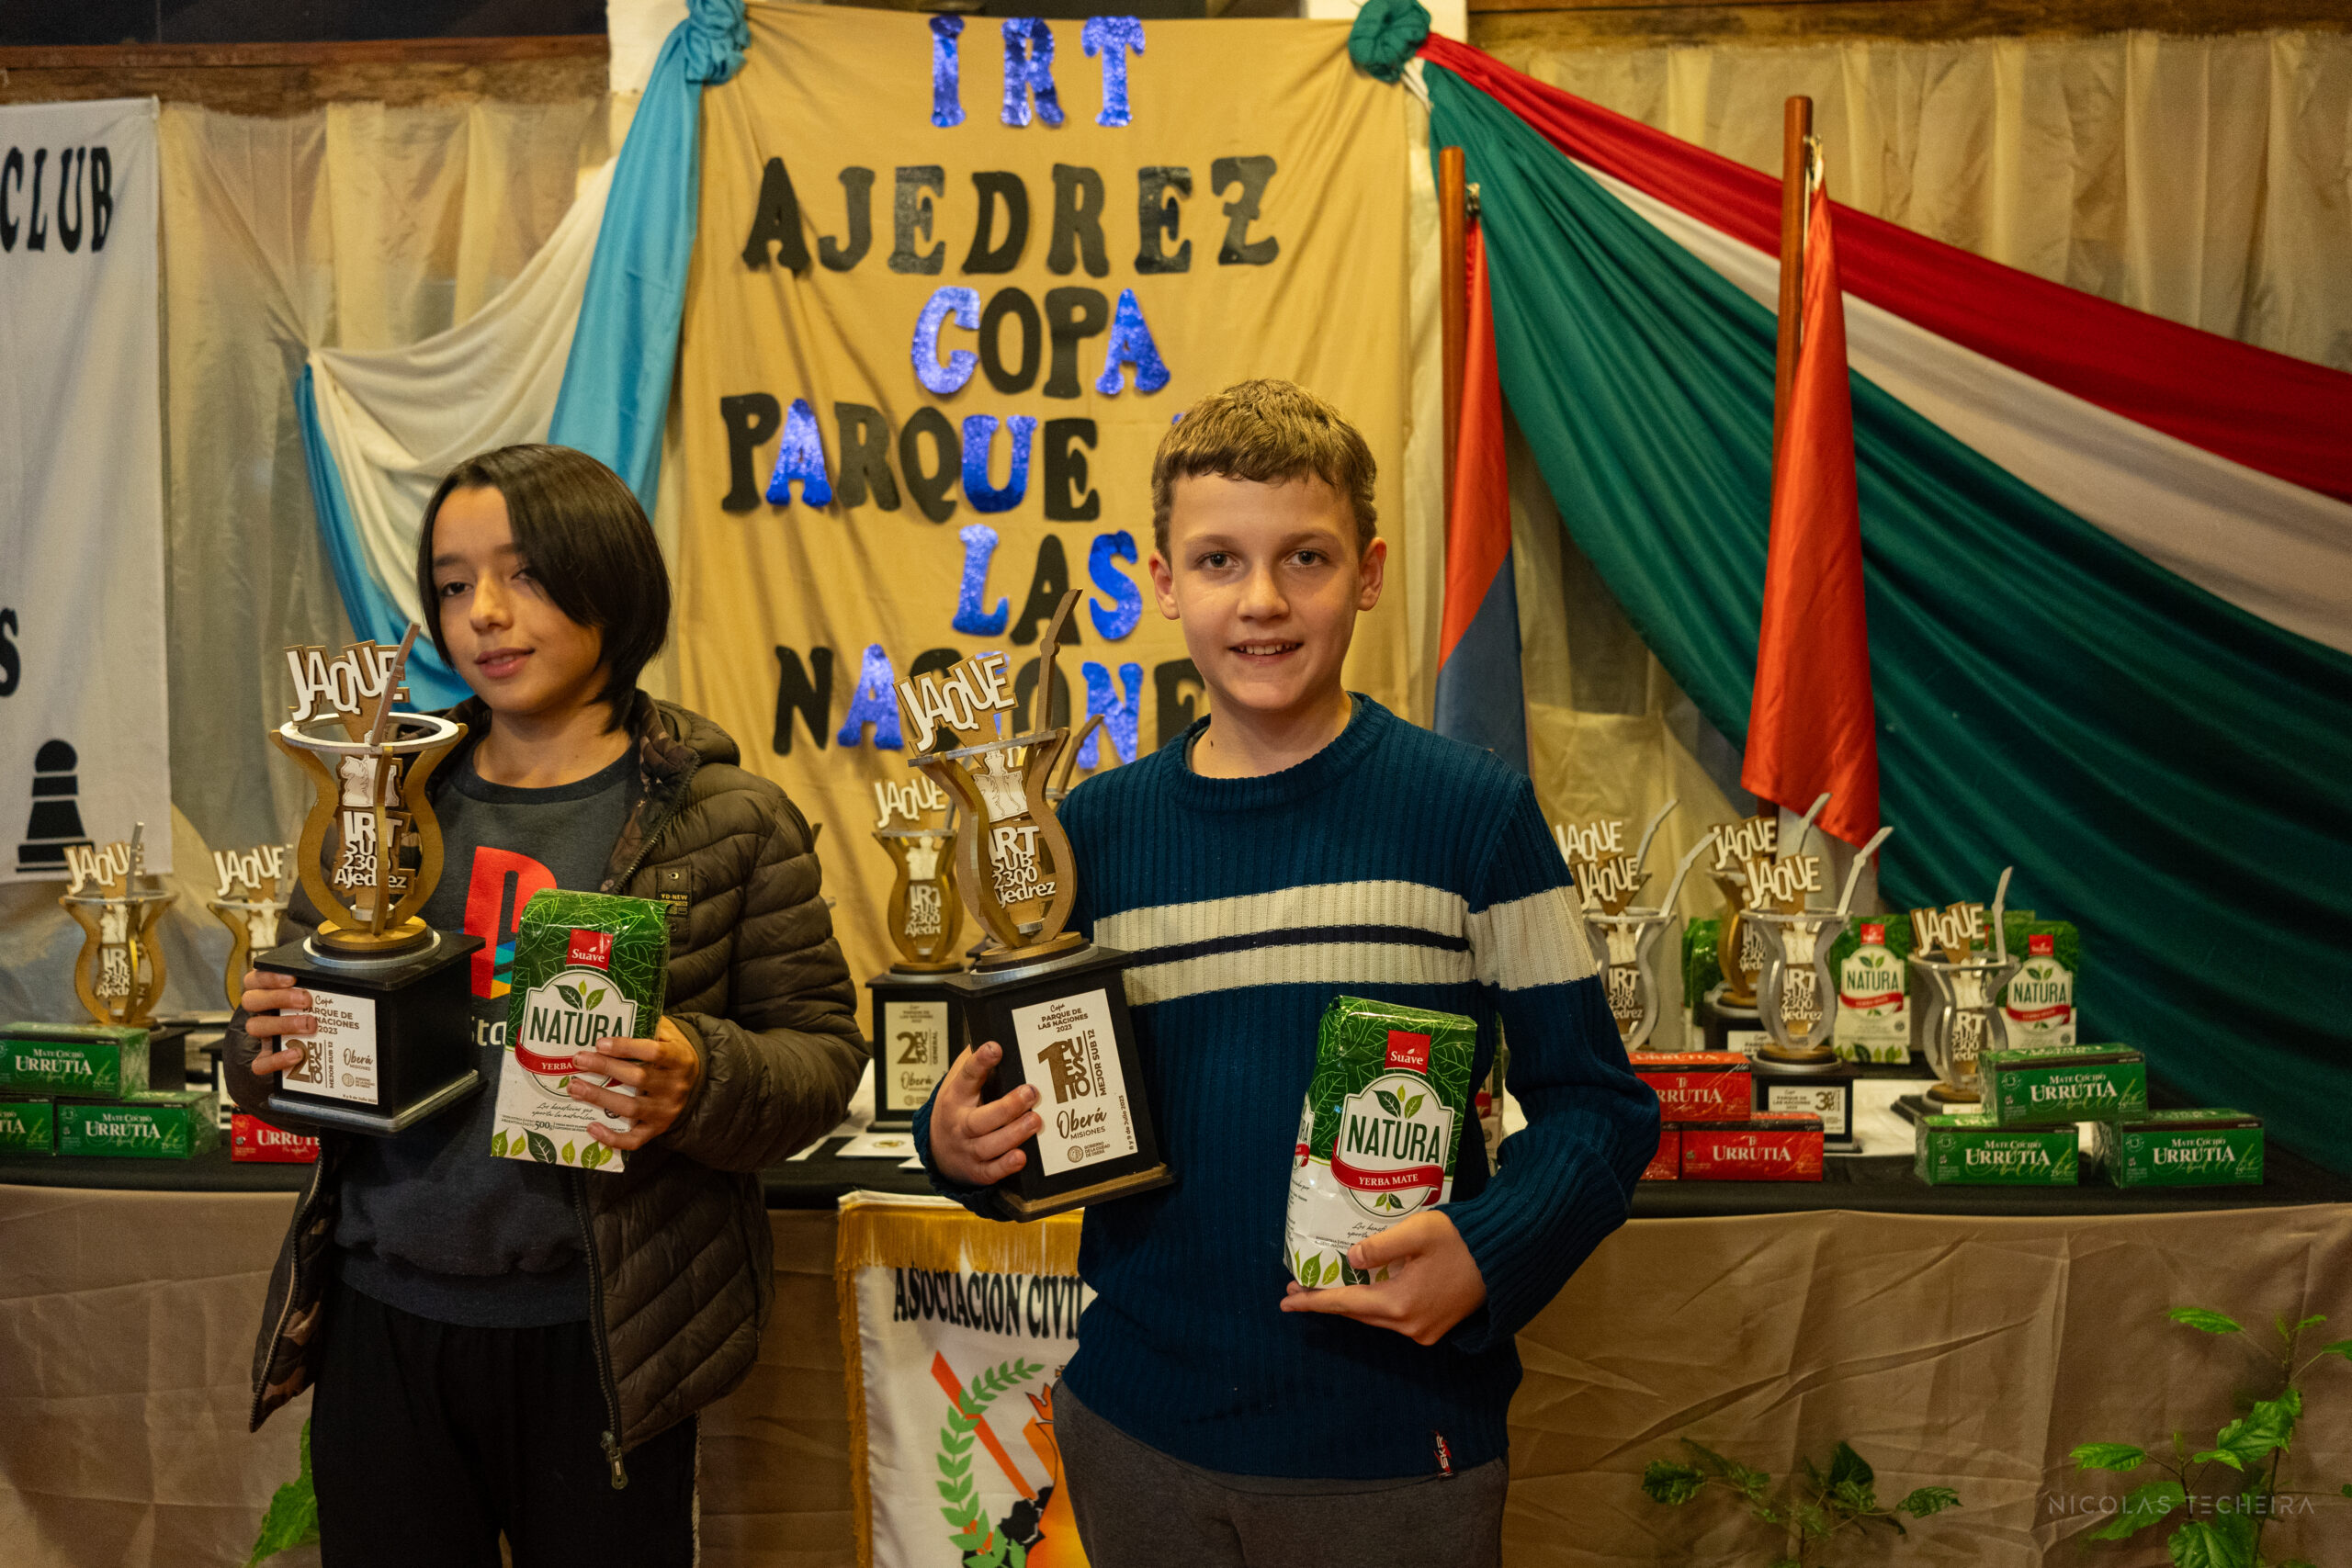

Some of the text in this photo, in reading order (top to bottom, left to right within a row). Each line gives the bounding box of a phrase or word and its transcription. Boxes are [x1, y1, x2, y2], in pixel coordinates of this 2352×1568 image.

[930, 16, 1148, 128] IRT
[0, 145, 114, 253] CLUB
[742, 155, 1281, 277] AJEDREZ
[911, 286, 1171, 399] COPA
[720, 393, 1102, 524] PARQUE
[952, 524, 1144, 646] LAS
[900, 653, 1016, 752] JAQUE
[874, 776, 946, 828] JAQUE
[345, 839, 378, 856] SU
[1713, 818, 1777, 870] JAQUE
[343, 854, 391, 872] 230
[992, 852, 1033, 873] SUB
[334, 866, 407, 889] Ajedez
[992, 866, 1038, 888] 2300
[1577, 856, 1640, 910] JAQUE
[1747, 855, 1821, 909] JAQUE
[995, 882, 1057, 908] jedrez
[1915, 905, 1985, 957] JAQUE
[571, 948, 605, 963] Suave
[1609, 967, 1640, 991] IRT
[1847, 970, 1899, 991] NATURA
[2013, 982, 2067, 1004] NATURA
[315, 1016, 360, 1030] NACIONES
[341, 1011, 353, 1020] DE
[1037, 1013, 1089, 1031] LAS NACIONES
[1042, 1010, 1068, 1022] PARQUE
[1954, 1011, 1987, 1034] RT
[318, 1025, 338, 1034] 2023
[471, 1015, 507, 1046] ta
[529, 1006, 623, 1047] NATURA
[1057, 1025, 1072, 1033] 2023
[33, 1048, 55, 1057] MATE
[343, 1047, 374, 1066] Oberá
[1088, 1029, 1107, 1096] MEJOR SUB 12
[1391, 1052, 1424, 1066] Suave
[15, 1055, 93, 1076] URRUTIA
[541, 1062, 572, 1071] YERBA
[2049, 1075, 2074, 1085] MATE
[1657, 1088, 1723, 1103] RRUTIA
[2030, 1080, 2118, 1102] URRUTIA
[102, 1112, 123, 1122] MATE
[1057, 1107, 1107, 1139] Oberá
[85, 1121, 162, 1139] URRUTIA
[1070, 1126, 1106, 1140] MISIONES
[1347, 1114, 1442, 1164] NATURA
[1713, 1145, 1792, 1162] URRUTIA
[1984, 1139, 2008, 1149] MATE
[2171, 1138, 2195, 1148] MATE
[1964, 1148, 2052, 1166] URRUTIA
[2153, 1145, 2235, 1165] URRUTIA
[1359, 1173, 1419, 1187] YERBA MATE
[893, 1266, 1023, 1337] ASOCIACION
